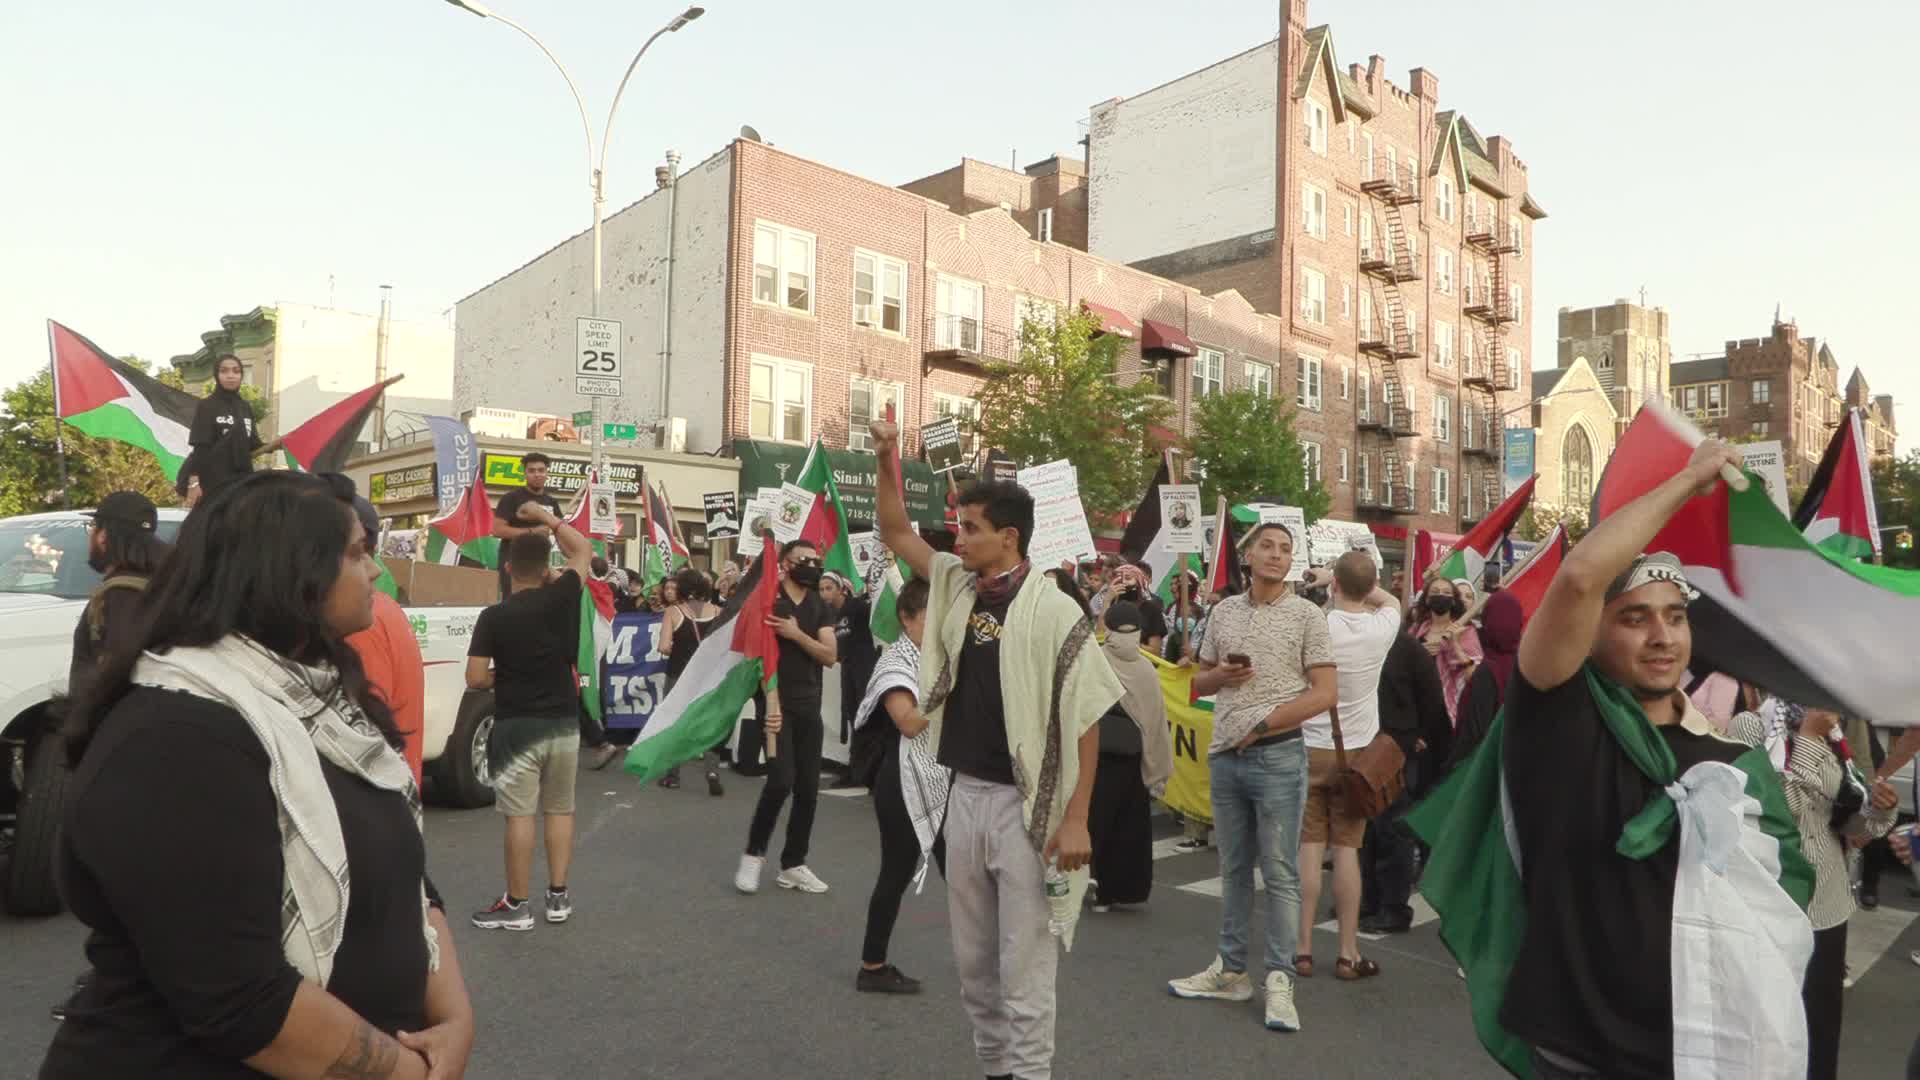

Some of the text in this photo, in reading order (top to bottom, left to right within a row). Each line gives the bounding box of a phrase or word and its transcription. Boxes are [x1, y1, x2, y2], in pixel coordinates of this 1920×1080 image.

[589, 322, 608, 330] CITY
[585, 330, 612, 339] SPEED
[587, 340, 609, 348] LIMIT
[582, 350, 616, 372] 25
[579, 386, 618, 395] ENFORCED
[586, 380, 611, 388] PHOTO
[546, 461, 637, 479] HECK CHING
[833, 469, 862, 485] Sinai
[544, 476, 563, 488] REE
[609, 481, 640, 494] DERS
[905, 477, 929, 493] Center
[445, 624, 466, 637] Truck
[606, 626, 638, 664] M
[606, 672, 667, 715] IST
